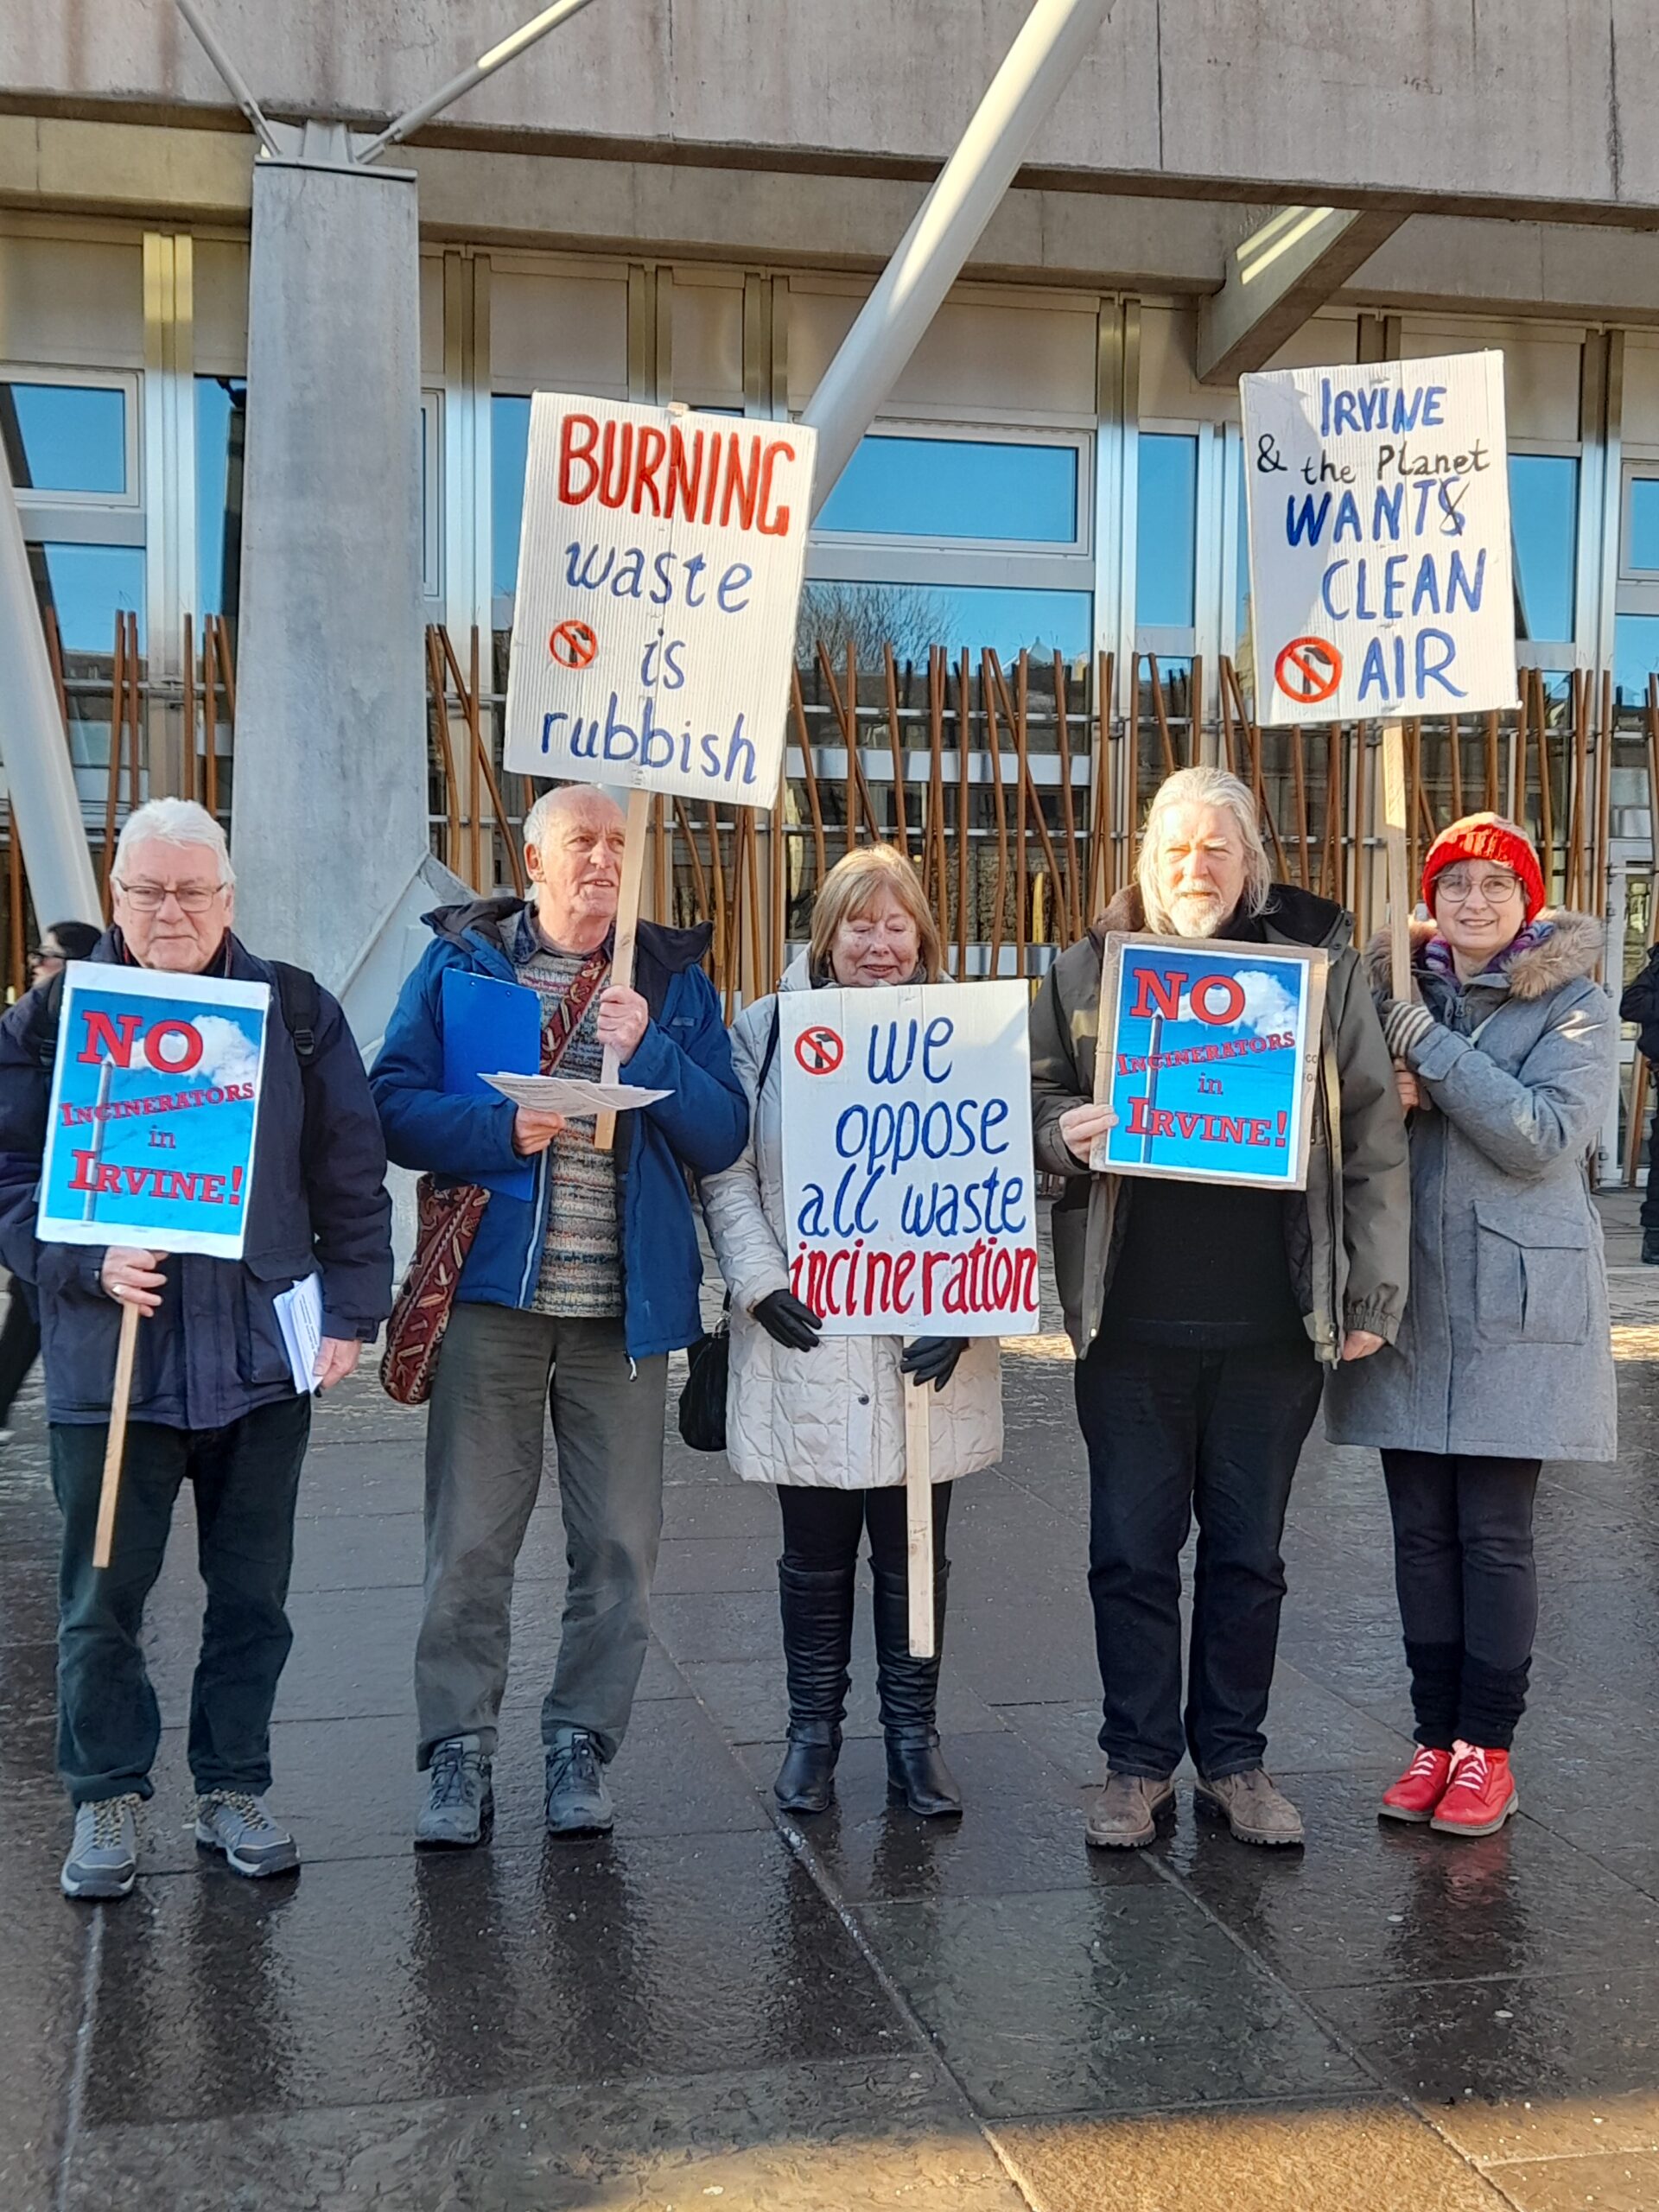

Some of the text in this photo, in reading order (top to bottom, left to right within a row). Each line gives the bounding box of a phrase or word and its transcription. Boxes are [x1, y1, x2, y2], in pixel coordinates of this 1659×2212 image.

[1320, 377, 1447, 437] IRVINE
[558, 413, 796, 537] BURNING
[1256, 433, 1491, 486] & the Planet
[565, 542, 753, 613] waste
[1321, 548, 1487, 620] CLEAN
[640, 628, 686, 690] is
[1357, 627, 1469, 702] AIR
[541, 691, 757, 785] rubbish
[1129, 968, 1246, 1026] NO
[77, 1009, 204, 1073] NO
[867, 1016, 955, 1085] we
[1116, 1031, 1296, 1077] INCINERATORS
[60, 1082, 255, 1127] INCINERATORS
[1198, 1072, 1224, 1096] in
[148, 1125, 176, 1149] in
[835, 1097, 1011, 1176] oppose
[1125, 1096, 1287, 1148] IRVINE!
[68, 1149, 244, 1205] IRVINE!
[797, 1162, 1027, 1238] all waste
[789, 1236, 1039, 1319] incineration
